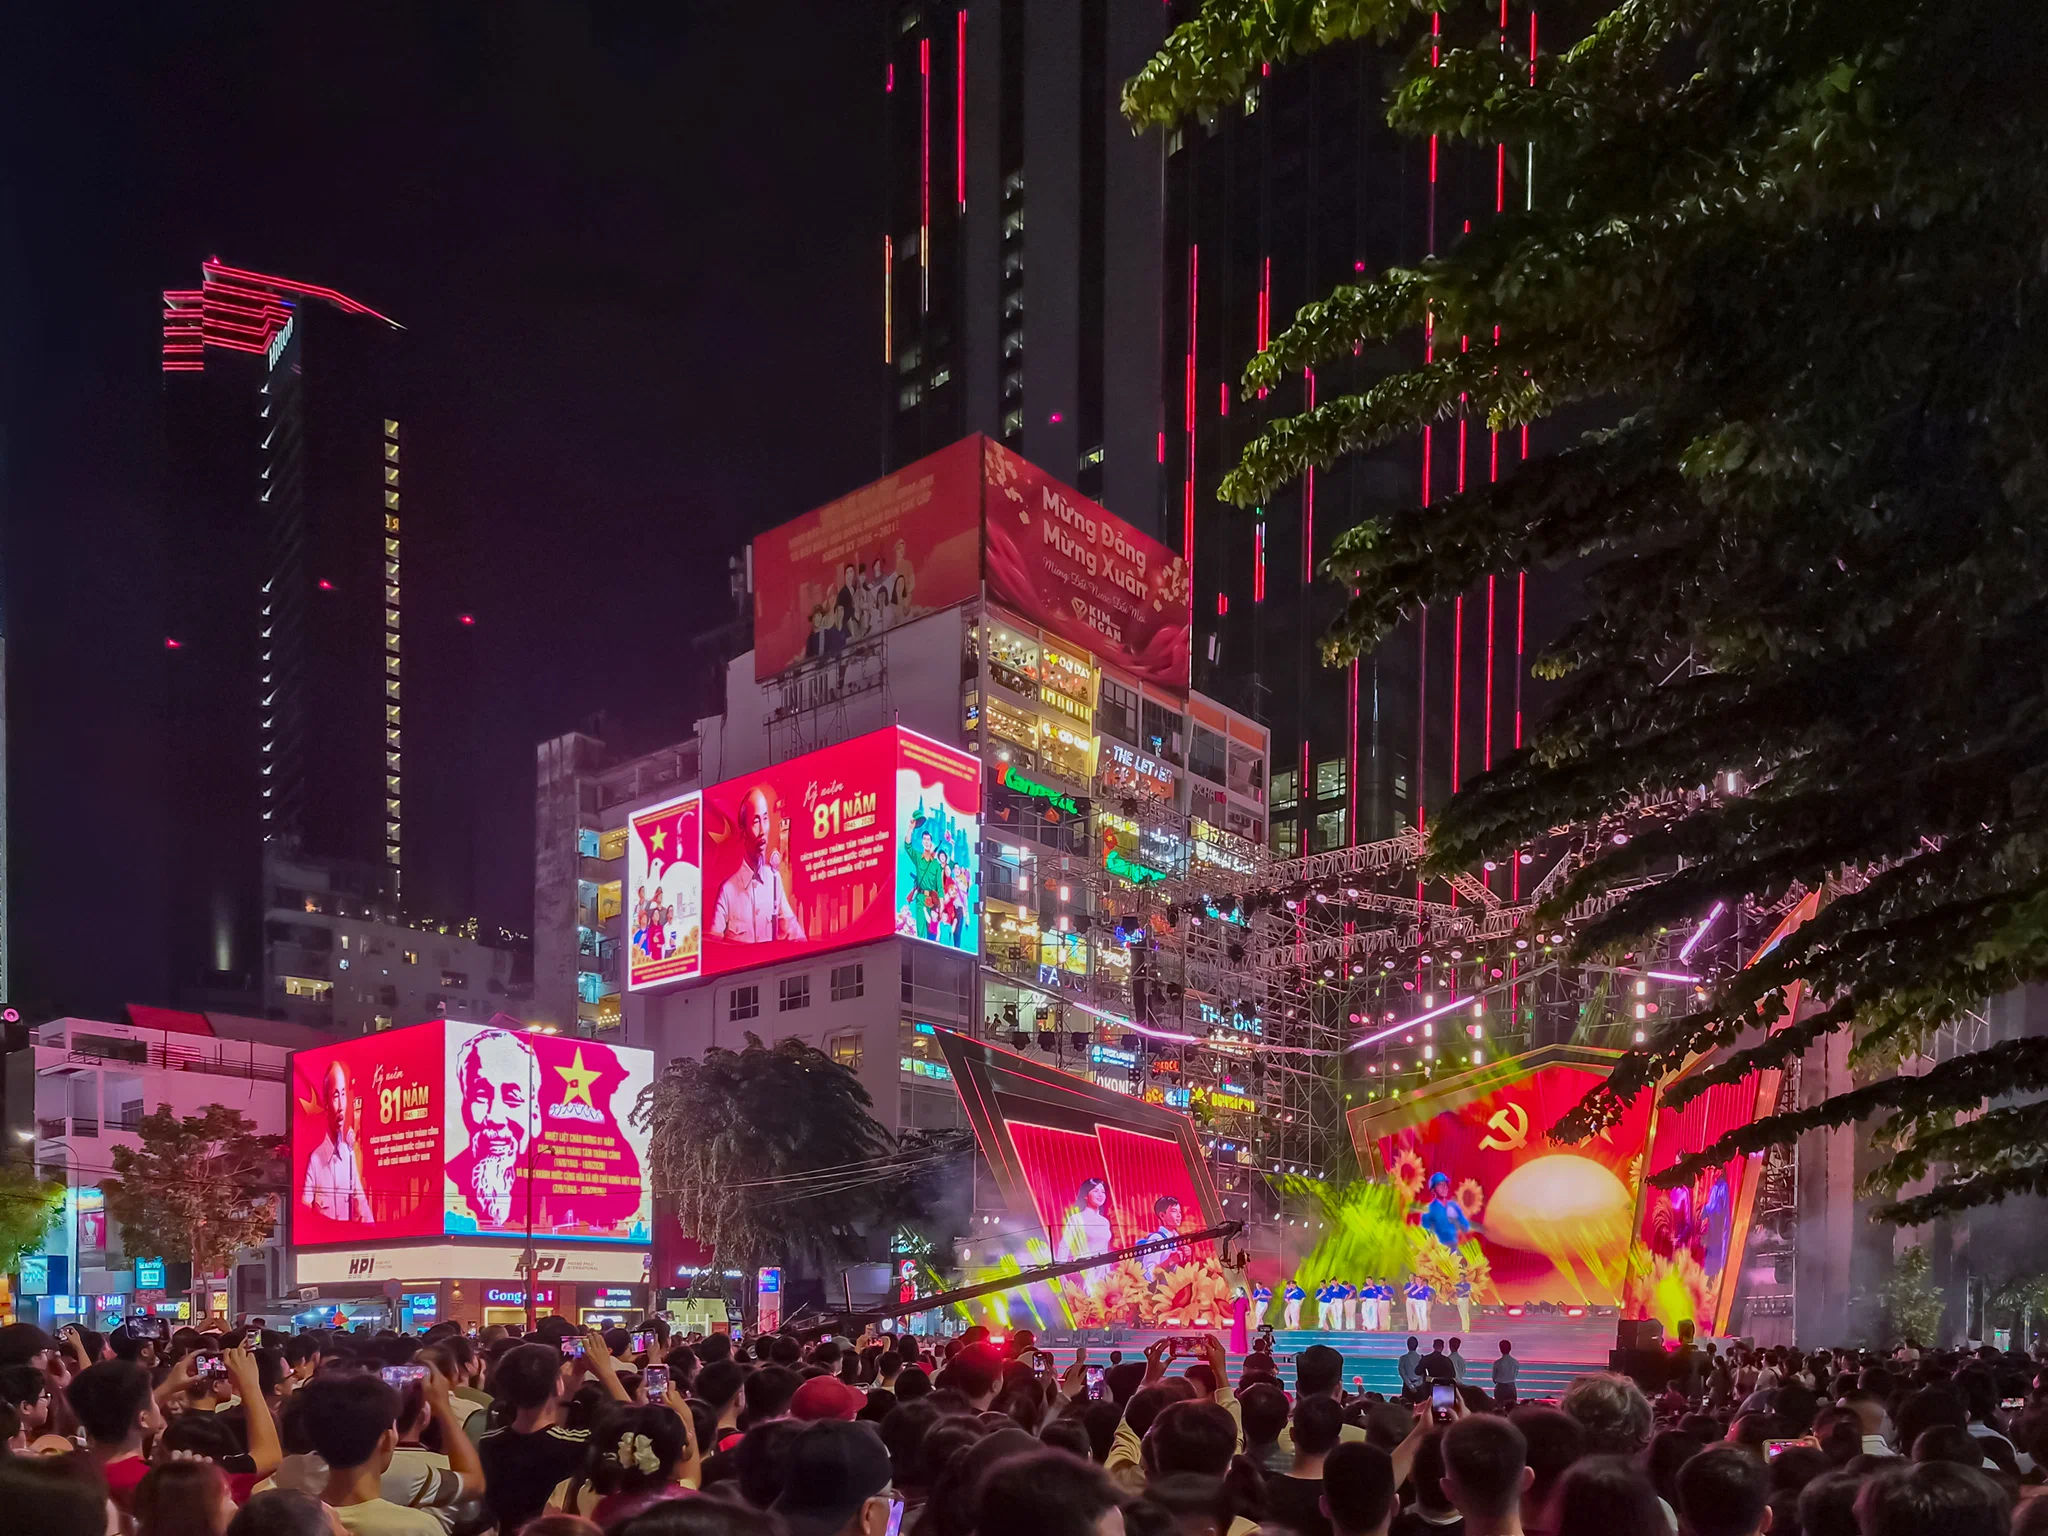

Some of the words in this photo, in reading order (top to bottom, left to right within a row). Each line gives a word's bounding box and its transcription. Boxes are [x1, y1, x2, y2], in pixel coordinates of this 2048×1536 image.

[269, 316, 293, 373] Hilton
[1043, 485, 1097, 544] Mừng
[1101, 521, 1146, 578] Đảng
[1044, 519, 1097, 576] Mừng
[1102, 554, 1148, 600] Xuân
[1089, 605, 1110, 624] KIM
[1113, 745, 1133, 767] THE
[813, 798, 840, 839] 81
[843, 791, 876, 819] NĂM
[380, 1086, 401, 1124] 81
[403, 1082, 429, 1108] NĂM
[349, 1258, 375, 1274] HPI
[488, 1289, 521, 1304] Gong
